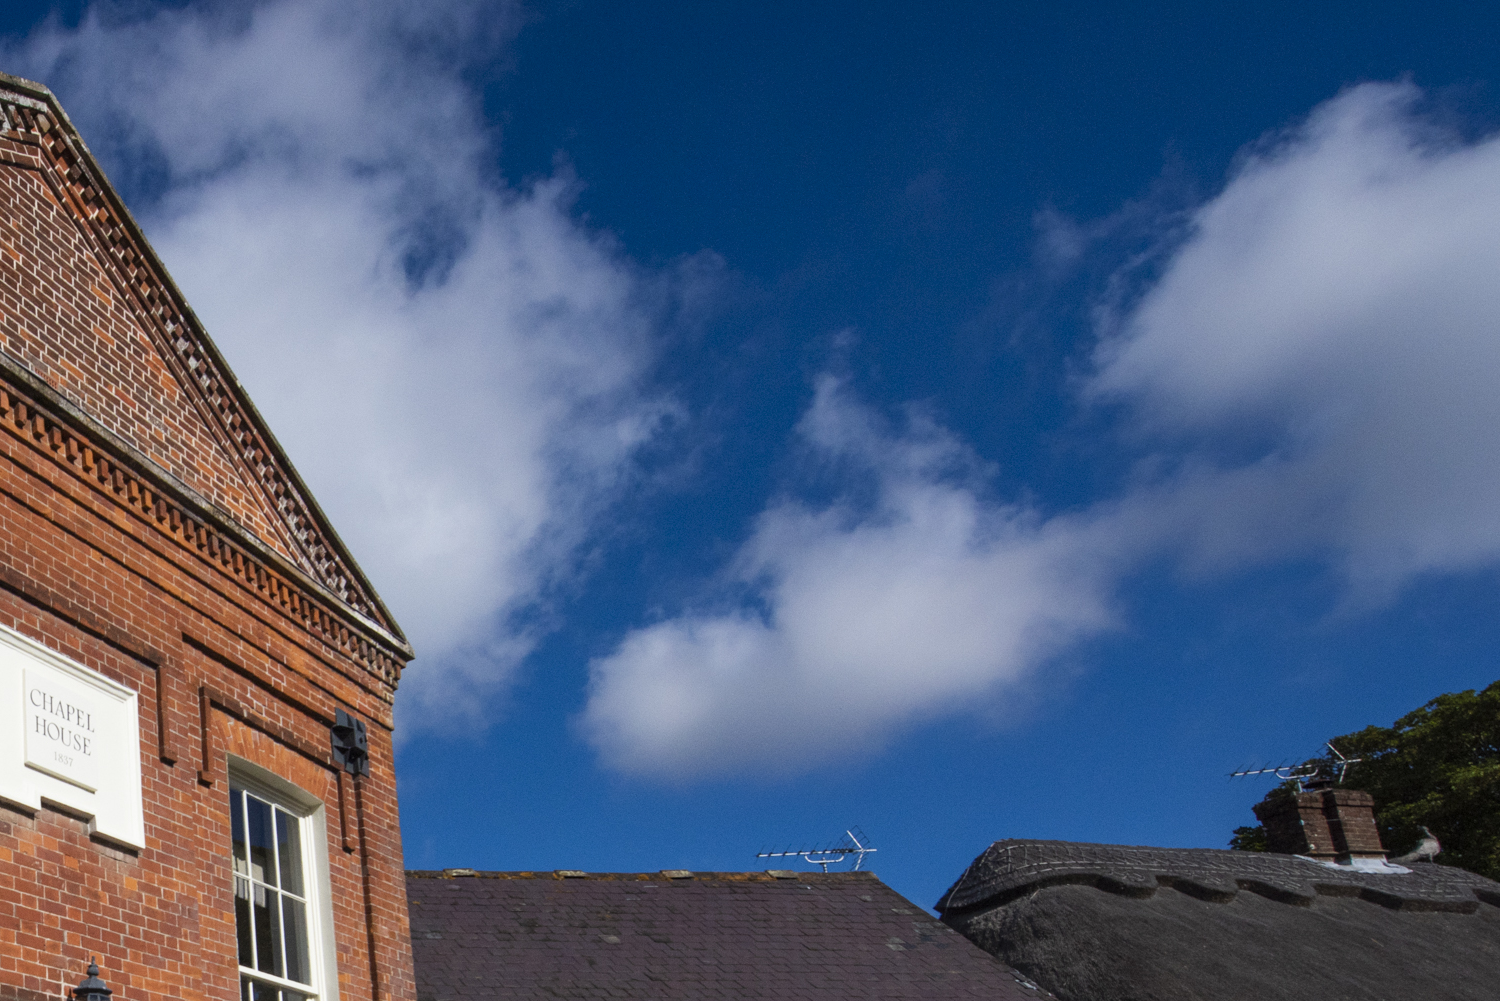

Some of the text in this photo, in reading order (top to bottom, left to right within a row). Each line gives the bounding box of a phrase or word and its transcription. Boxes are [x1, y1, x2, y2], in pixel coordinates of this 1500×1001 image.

[30, 688, 95, 733] CHAPEL
[34, 715, 91, 756] HOUSE
[54, 751, 74, 767] 1837
